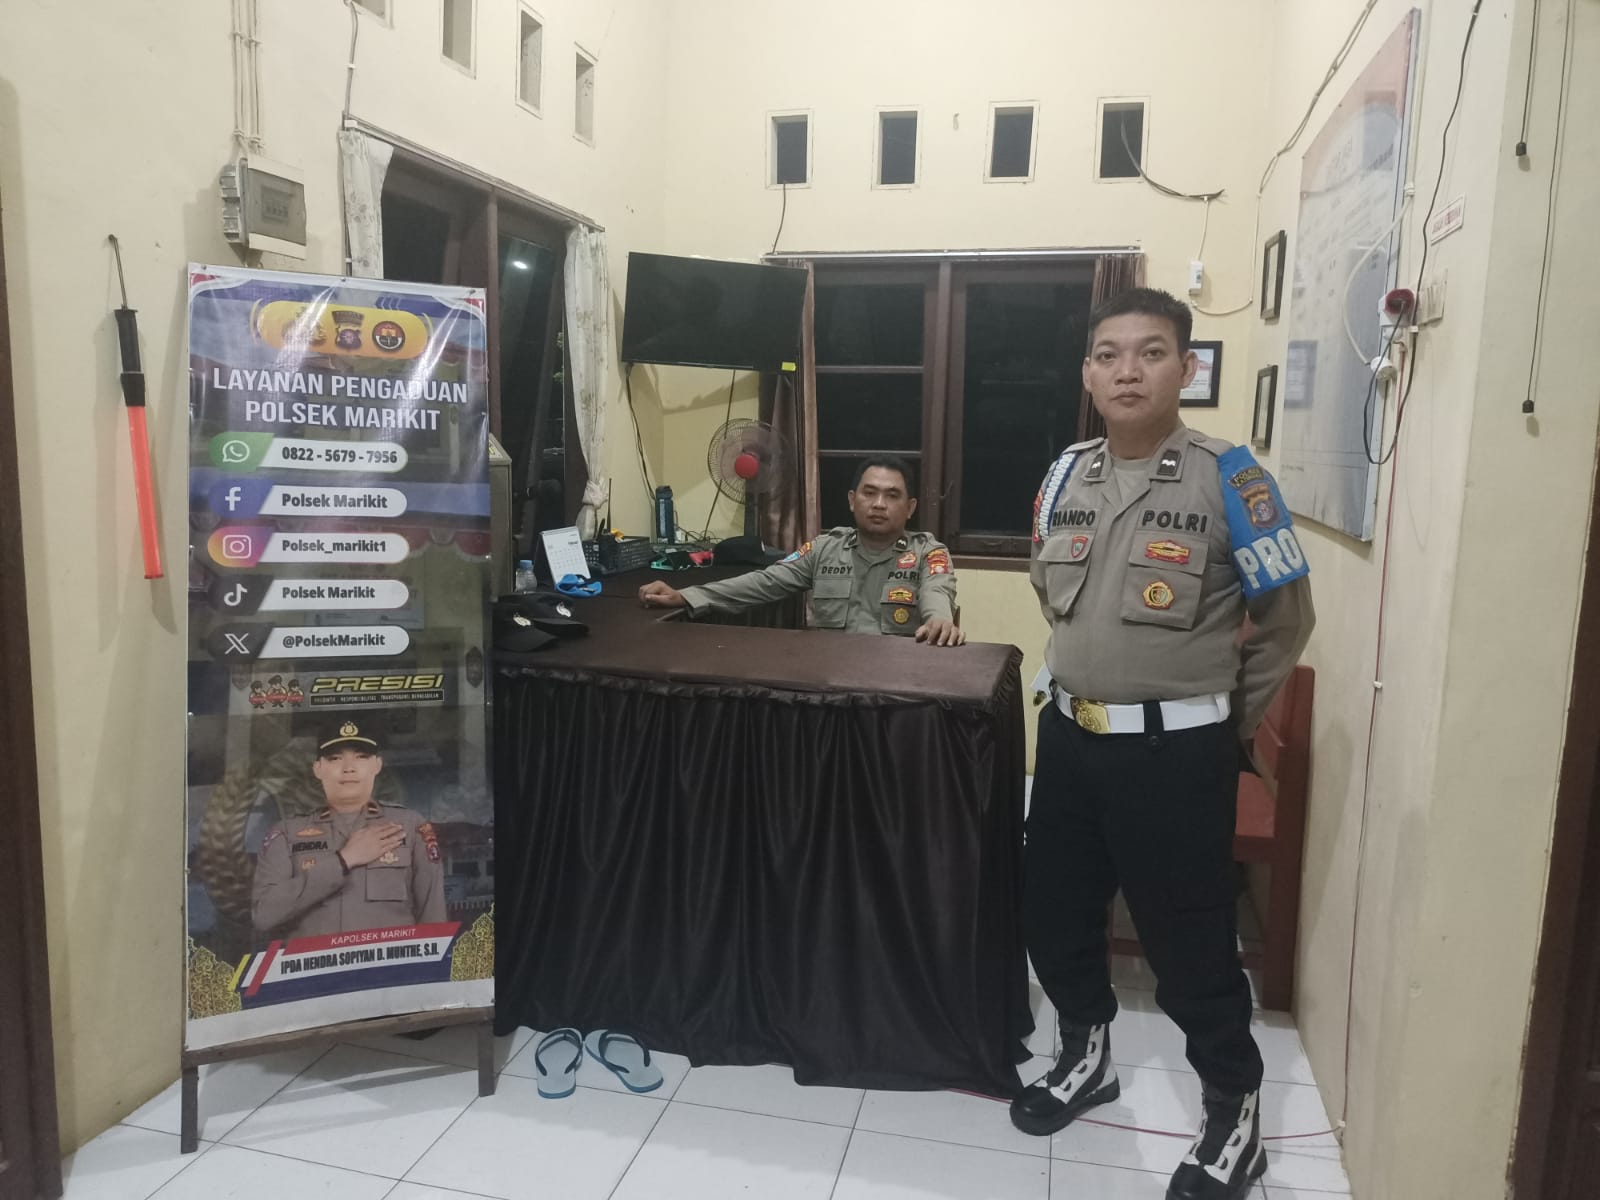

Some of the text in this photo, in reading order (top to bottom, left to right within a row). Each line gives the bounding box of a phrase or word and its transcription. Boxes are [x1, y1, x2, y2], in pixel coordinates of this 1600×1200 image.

[213, 367, 467, 403] LAYANAN PENGADUAN
[245, 400, 440, 430] POLSEK MARIKIT
[282, 446, 314, 461] 0822
[325, 449, 356, 462] 5679
[366, 450, 398, 463] 7956
[282, 493, 388, 508] Polsek Marikit
[1052, 509, 1096, 527] RIANDO
[1142, 510, 1207, 533] POLRI
[282, 540, 386, 554] Polsek_marikit1
[821, 565, 853, 575] DEDDY
[887, 571, 920, 580] POLRI
[282, 586, 375, 599] Polsek Marikit
[282, 634, 386, 649] @PolsekMarikit
[312, 674, 444, 693] PRESISI
[292, 841, 329, 852] HENDRA
[331, 928, 416, 945] KAPOLSEK MARIKIT
[281, 942, 440, 974] IPDA HENDRA SOPIYAN D. MUNTHE, S.H.
